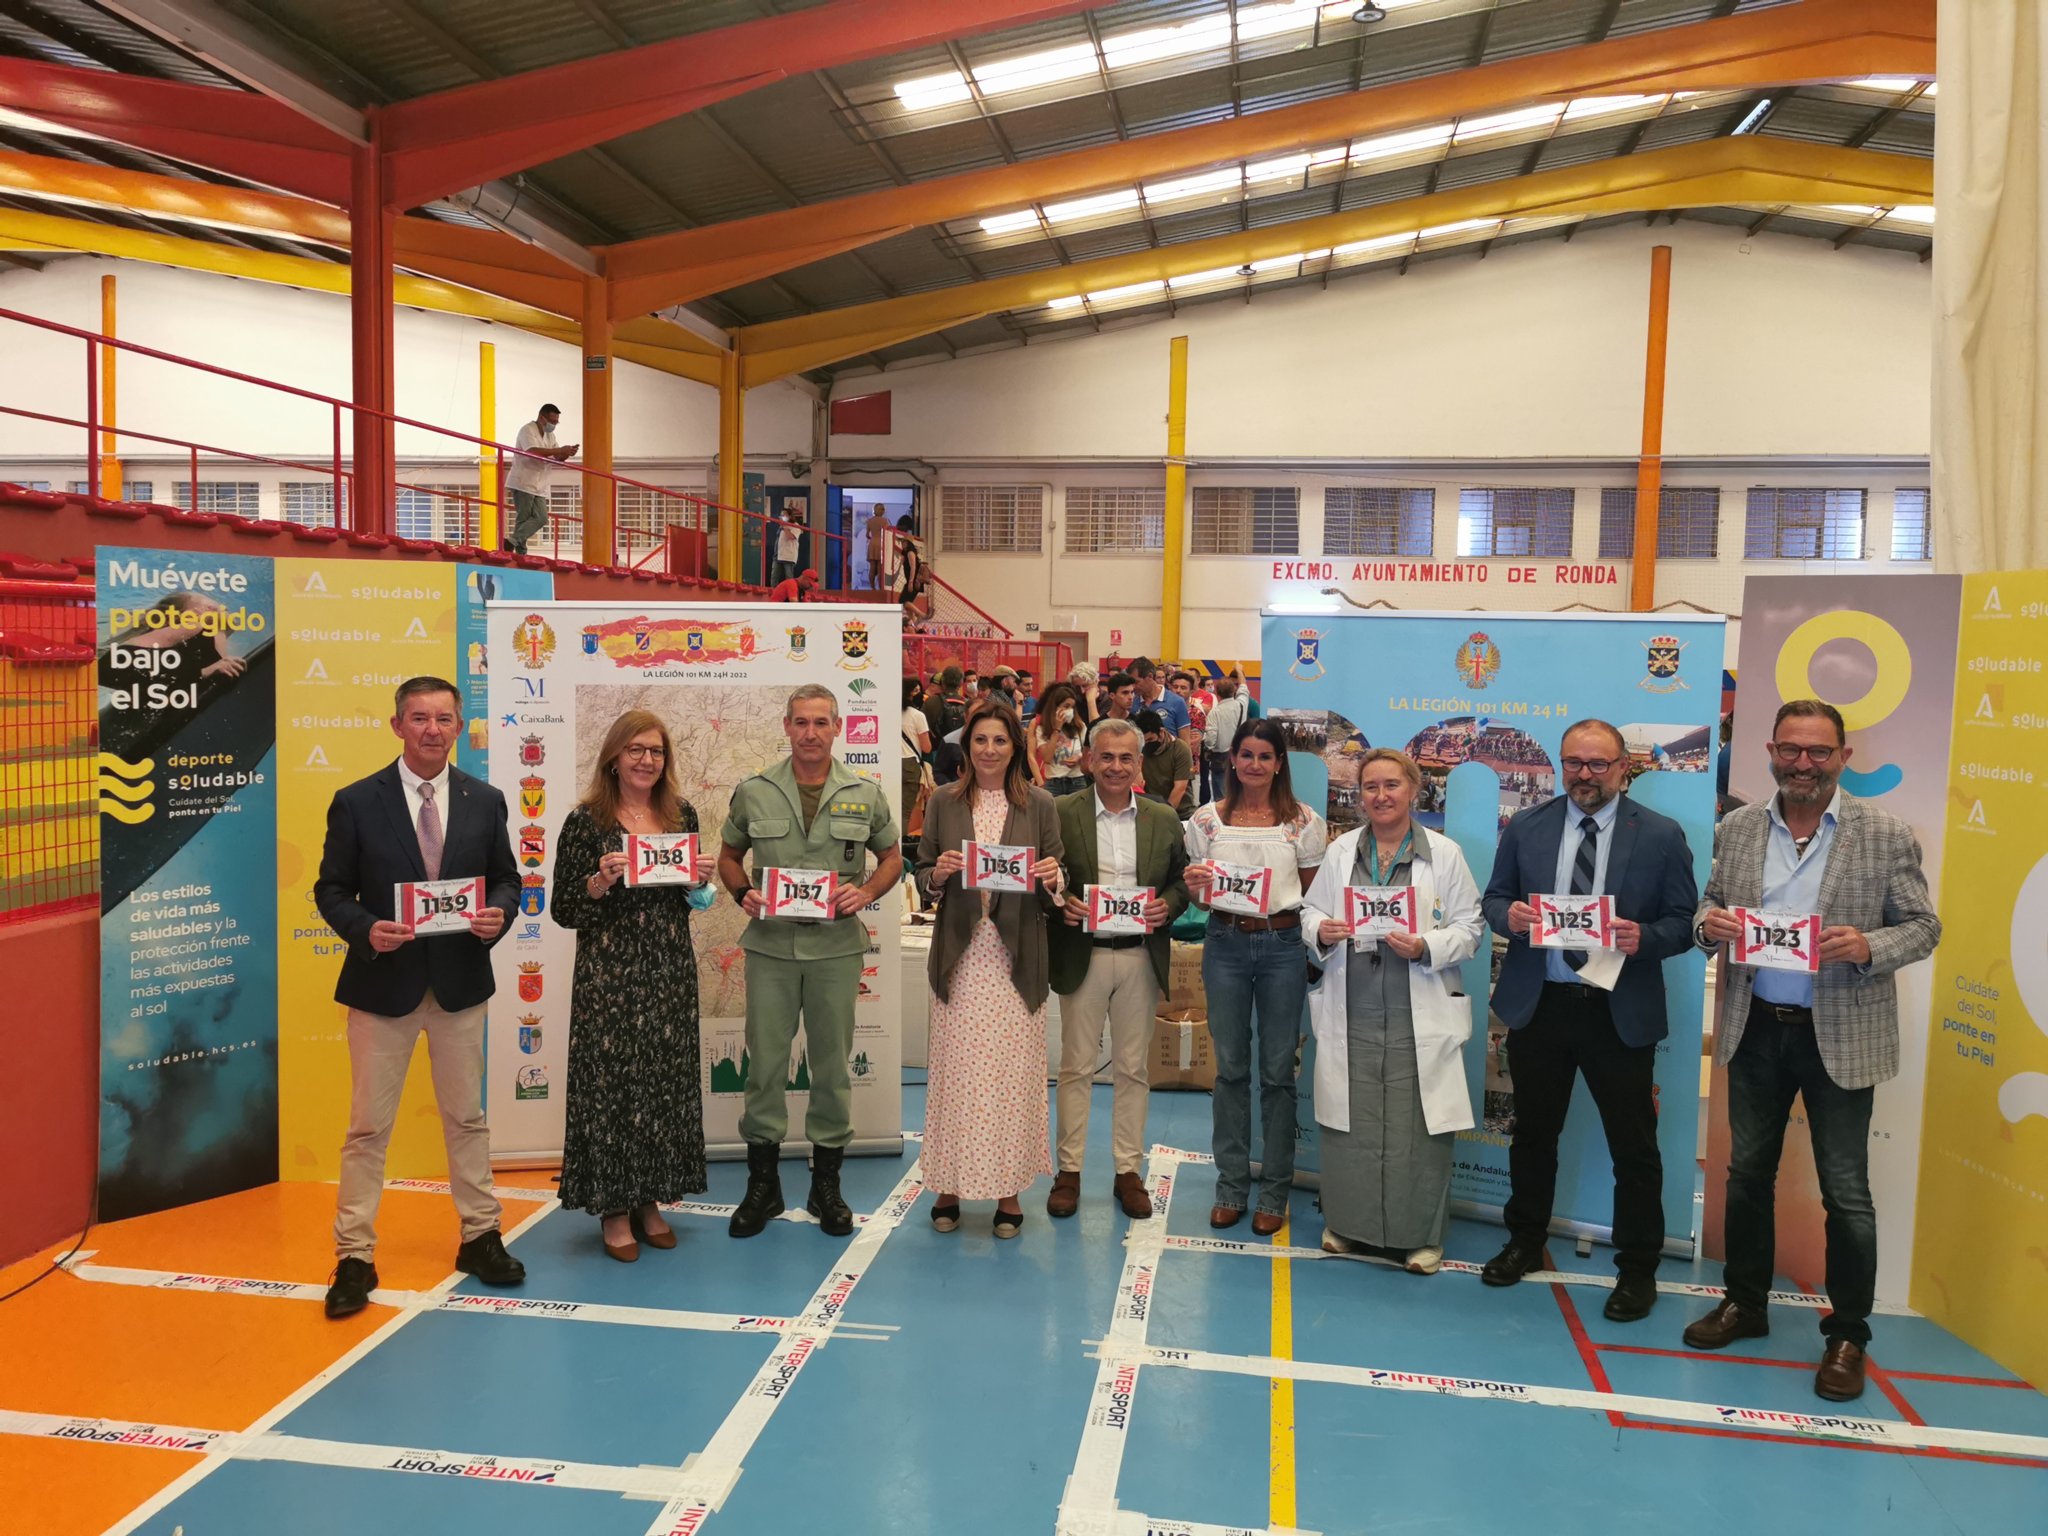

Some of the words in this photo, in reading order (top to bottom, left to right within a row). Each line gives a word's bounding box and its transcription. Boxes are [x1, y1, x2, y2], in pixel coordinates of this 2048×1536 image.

[109, 560, 248, 593] Muévete
[1273, 562, 1338, 580] EXCMO.
[1352, 563, 1488, 583] AYUNTAMIENTO
[1508, 567, 1537, 583] DE
[1555, 565, 1617, 584] RONDA
[109, 605, 266, 637] protegido
[110, 642, 182, 677] bajo
[655, 669, 684, 678] LEGIÓN
[111, 683, 140, 710] el
[147, 683, 197, 709] Sol
[1389, 698, 1408, 710] LA
[1412, 696, 1471, 712] LEGIÓN
[1476, 703, 1497, 713] 101
[1502, 702, 1527, 715] KM
[1532, 705, 1551, 718] 24
[1556, 704, 1568, 716] H
[521, 713, 565, 724] CaixaBank
[168, 753, 234, 768] deporte
[205, 796, 218, 804] del
[169, 808, 197, 818] ponte
[199, 806, 210, 815] en
[212, 804, 222, 813] tu
[224, 805, 241, 813] Piel
[643, 849, 683, 865] 1138
[982, 858, 1020, 875] 1136
[130, 890, 159, 904] Los
[162, 884, 212, 900] estilos
[784, 884, 822, 900] 1137
[1218, 877, 1256, 895] 1127
[130, 910, 151, 923] de
[154, 905, 187, 920] vida
[190, 901, 221, 915] más
[421, 895, 468, 914] 1139
[1104, 900, 1141, 916] 1128
[1360, 901, 1401, 917] 1126
[130, 922, 212, 942] saludables
[215, 922, 223, 932] y
[226, 917, 237, 929] la
[1548, 912, 1593, 928] 1125
[1753, 926, 1801, 948] 1123
[130, 940, 207, 964] protección
[210, 935, 250, 950] frente
[313, 944, 329, 955] tu
[333, 944, 347, 955] Pi
[130, 968, 151, 981] las
[153, 955, 233, 977] actividades
[130, 985, 161, 999] más
[164, 973, 235, 994] expuestas
[130, 1005, 143, 1018] al
[146, 1001, 168, 1015] sol
[1957, 999, 1974, 1013] del
[1943, 1017, 1978, 1038] ponte
[1980, 1030, 1996, 1045] en
[1957, 1042, 1969, 1057] tu
[1971, 1047, 1994, 1067] Piel
[1459, 1161, 1471, 1169] de
[1473, 1164, 1512, 1177] Andaluc
[1164, 1236, 1247, 1250] ERSPORT
[191, 1275, 302, 1291] INTERSPORT
[463, 1296, 583, 1313] INTERSPORT
[1129, 1271, 1153, 1321] INTERSPORT
[763, 1336, 816, 1400] INTERSPORT
[1391, 1373, 1526, 1394] INTERSPORT
[1739, 1410, 1887, 1433] INTERSPORT
[51, 1426, 188, 1449] INTERSPORT
[387, 1458, 534, 1482] INTERSPORT
